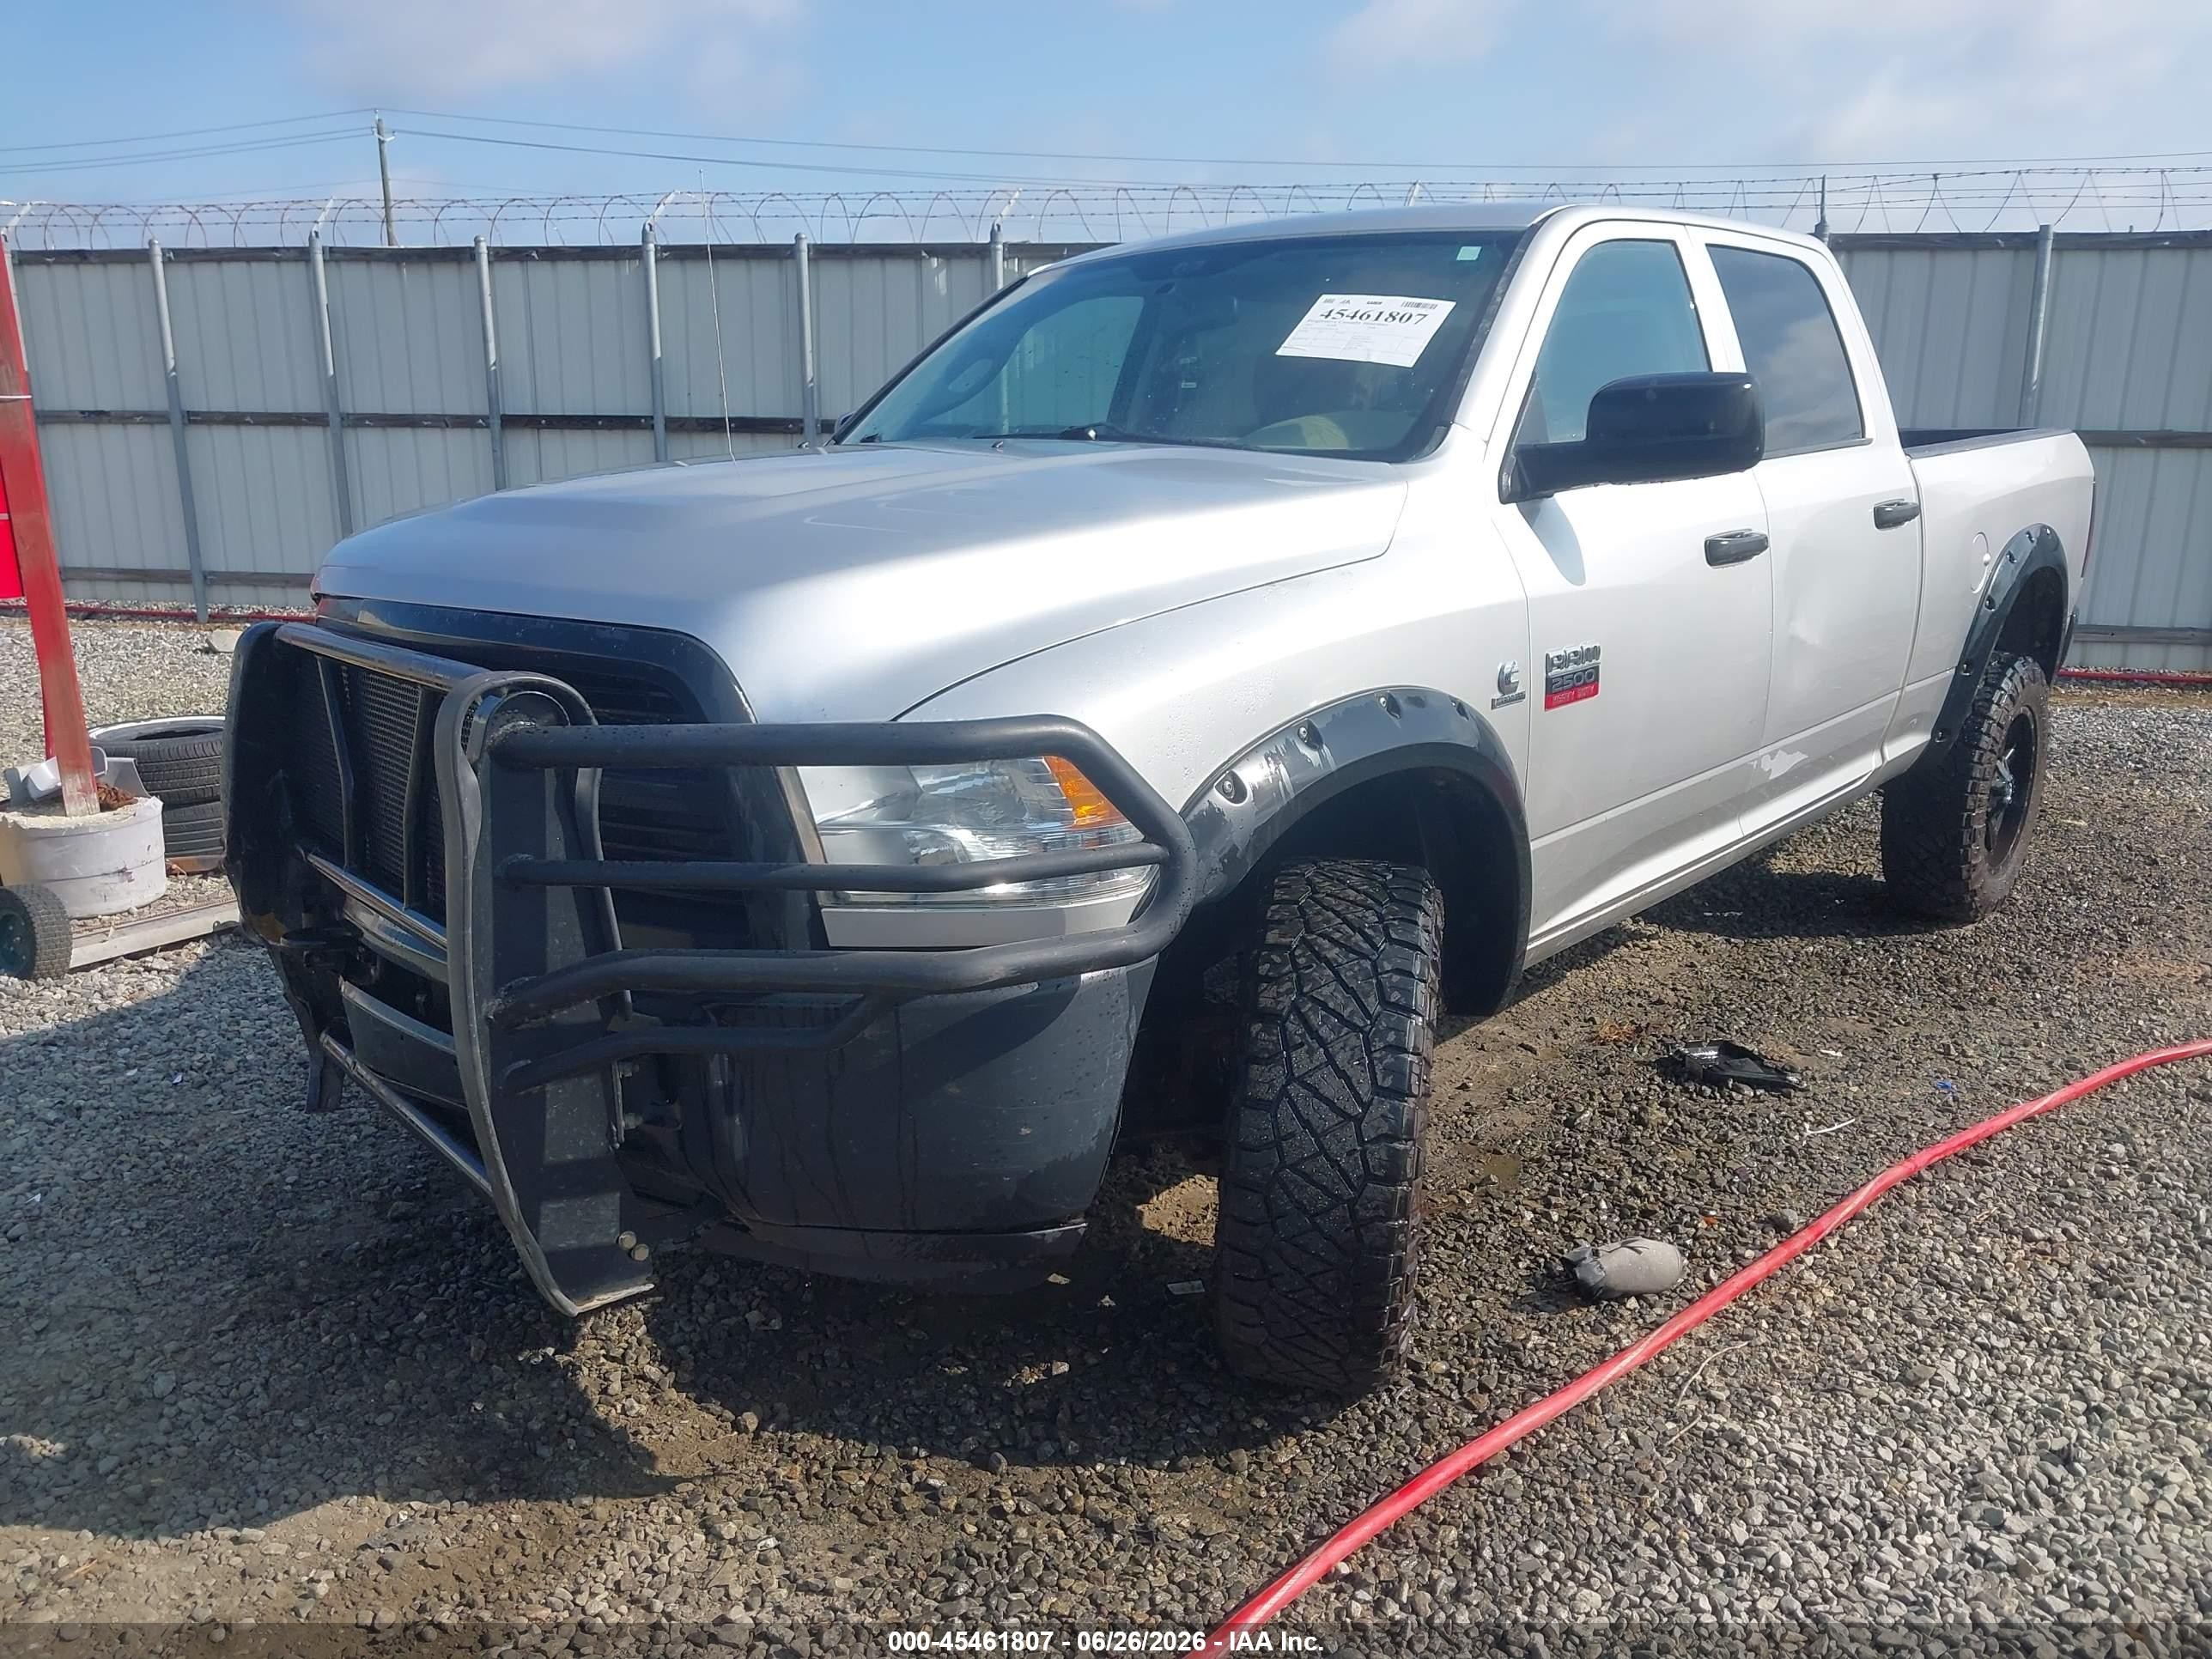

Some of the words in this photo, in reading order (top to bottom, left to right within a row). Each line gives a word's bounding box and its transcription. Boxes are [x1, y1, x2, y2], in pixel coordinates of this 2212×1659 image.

[1320, 308, 1429, 325] 45461807
[1545, 643, 1601, 674] RAM
[1552, 668, 1595, 692] 2500
